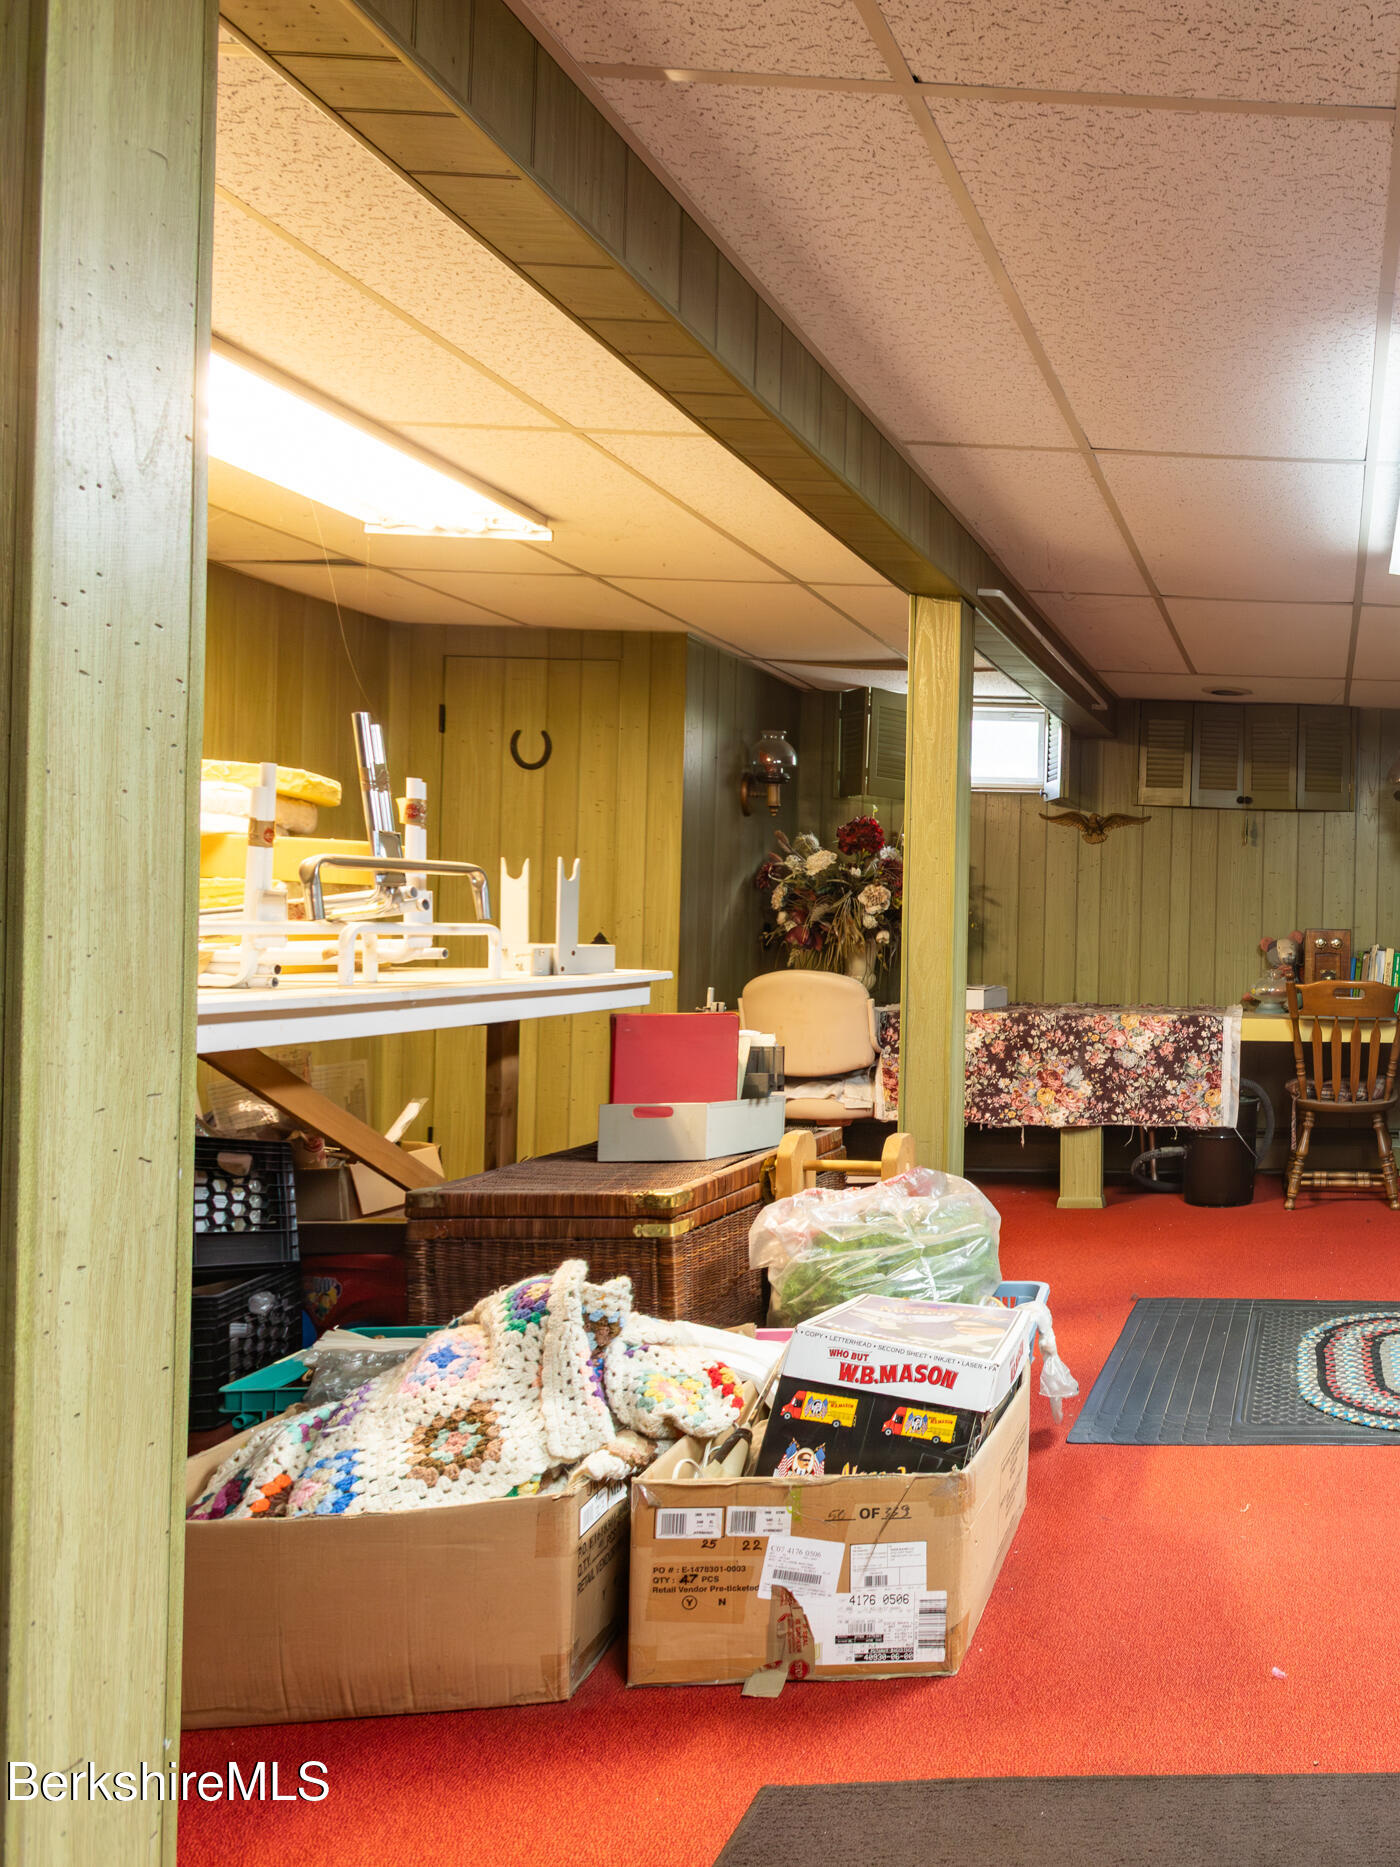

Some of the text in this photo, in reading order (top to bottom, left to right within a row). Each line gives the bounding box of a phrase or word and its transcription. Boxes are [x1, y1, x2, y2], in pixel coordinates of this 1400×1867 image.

[805, 1331, 824, 1339] COPY
[829, 1335, 872, 1349] LETTERHEAD
[878, 1344, 906, 1355] SECOND
[906, 1350, 928, 1359] SHEET
[933, 1355, 956, 1364] INKJET
[961, 1360, 983, 1369] LASER
[829, 1348, 870, 1362] WHO BUT
[859, 1507, 880, 1520] OF
[701, 1539, 718, 1550] 25
[652, 1566, 666, 1574] PO
[679, 1573, 699, 1585] 47
[652, 1585, 677, 1593] Retail
[678, 1585, 708, 1593] Vendor
[718, 1598, 727, 1606] N
[849, 1593, 910, 1606] 4176 0506
